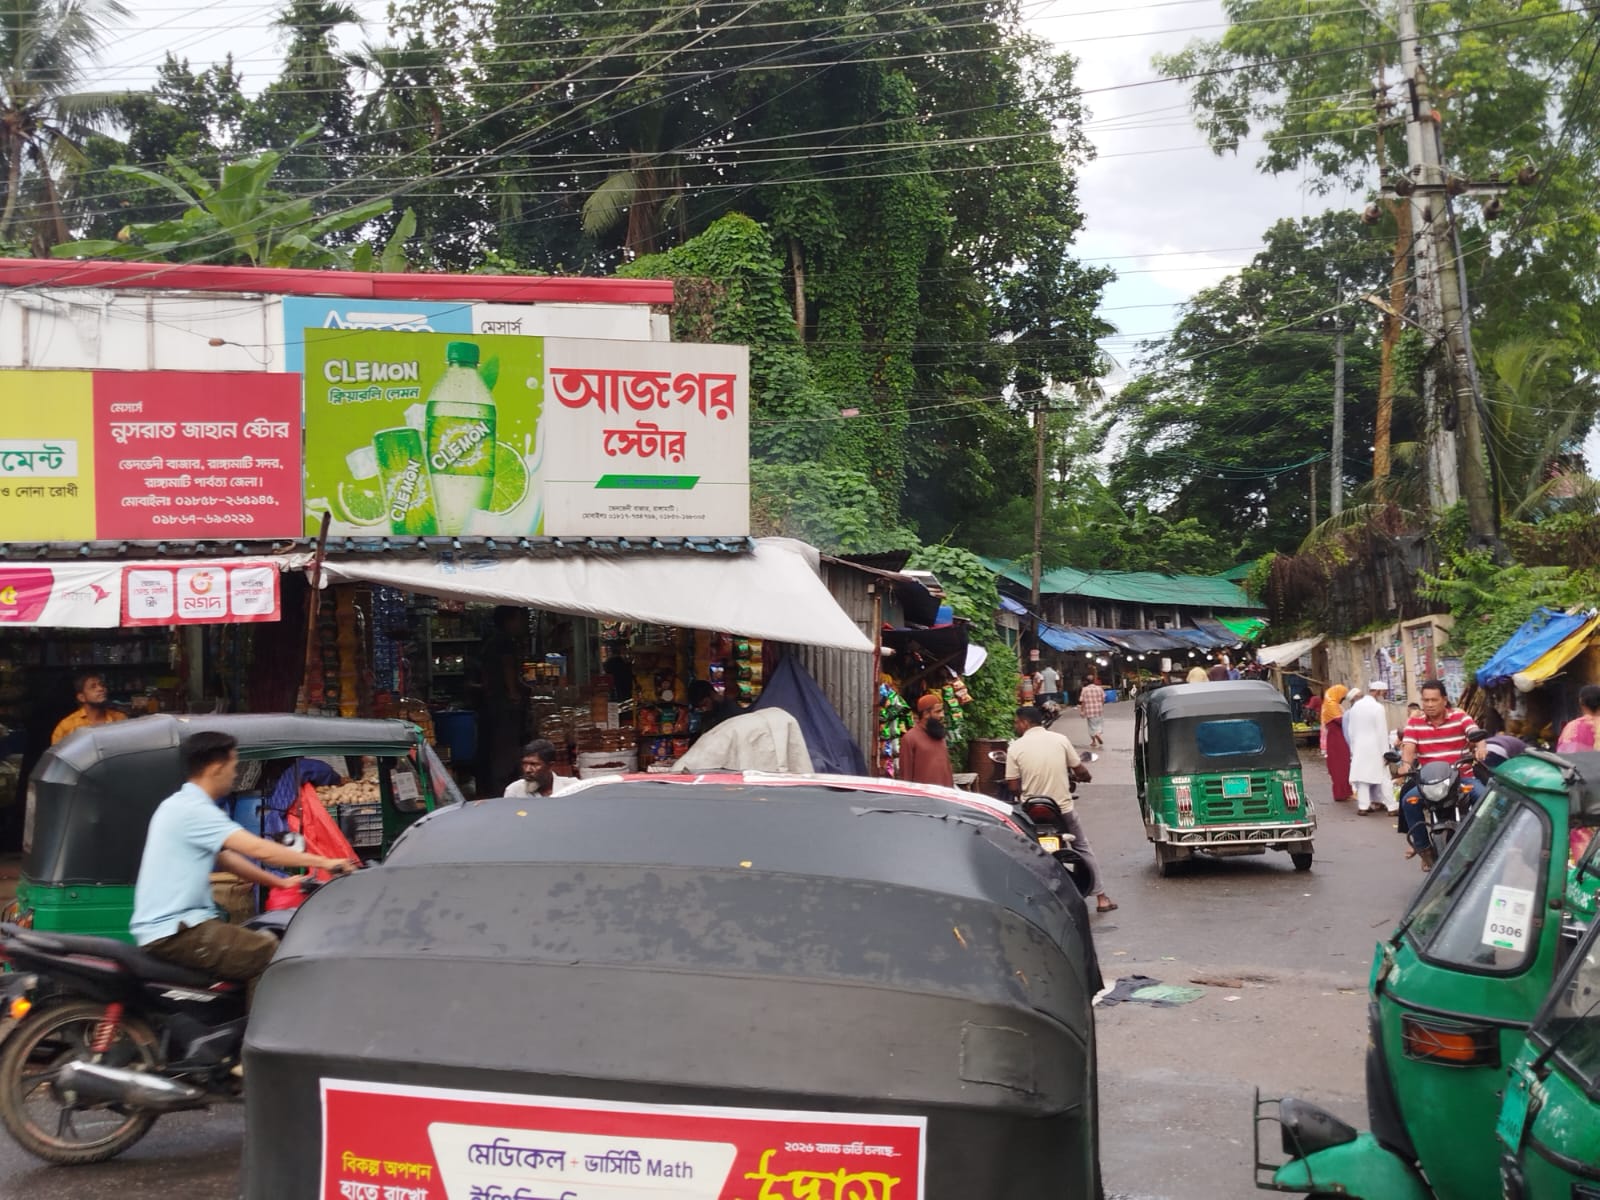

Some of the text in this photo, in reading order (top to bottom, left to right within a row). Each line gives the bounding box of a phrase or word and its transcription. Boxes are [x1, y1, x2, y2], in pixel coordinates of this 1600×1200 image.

[324, 359, 420, 383] CLEMON
[385, 386, 420, 401] লেমন
[549, 367, 737, 420] আজগর
[110, 401, 143, 413] মেসার্স
[110, 418, 290, 444] নুসরাত জাহান ষ্টোর
[602, 419, 687, 463] স্টোর
[0, 443, 66, 472] মেন্ট
[431, 420, 491, 470] CLEMON
[16, 487, 45, 498] নোনা
[48, 482, 78, 497] রোধী
[390, 458, 421, 522] CLEMON
[184, 597, 222, 610] নগদ
[1490, 923, 1523, 938] 0306
[467, 1137, 567, 1172] মেডিকেল
[584, 1150, 642, 1175] ভার্সিটি
[646, 1159, 693, 1179] Math
[784, 1142, 815, 1154] ২০২৬
[342, 1151, 433, 1182] বিকল্প অপশন
